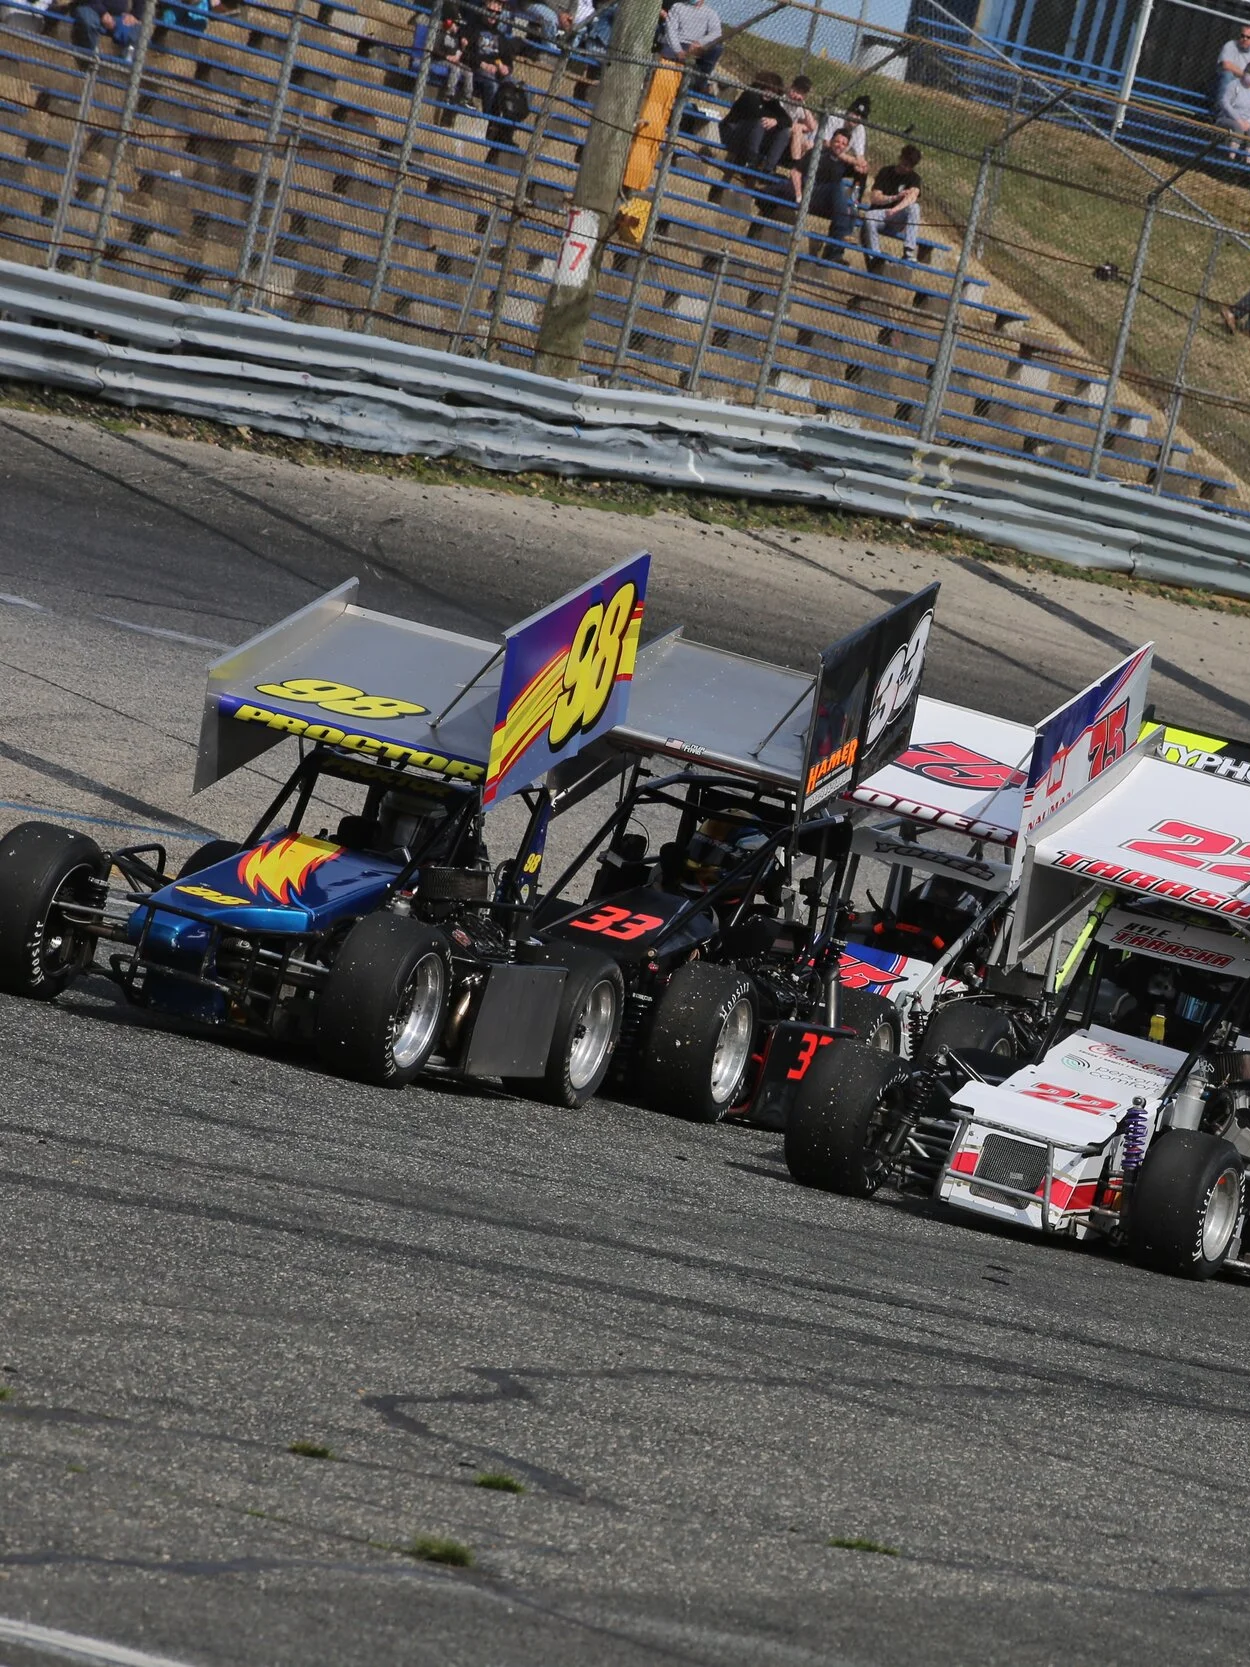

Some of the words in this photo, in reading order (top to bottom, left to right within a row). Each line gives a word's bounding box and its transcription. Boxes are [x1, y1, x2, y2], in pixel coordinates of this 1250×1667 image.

[546, 579, 638, 754] 98
[864, 607, 936, 760] 33
[253, 677, 432, 721] 98
[232, 704, 487, 783] PROCTOR
[805, 736, 859, 796] HAMER
[852, 787, 1014, 844] ODER
[523, 853, 542, 874] 98
[174, 885, 253, 906] 98
[568, 904, 665, 941] 33
[1123, 921, 1172, 941] KYLE
[1109, 930, 1236, 969] TARASHA
[1089, 1071, 1161, 1093] comfort
[1095, 1066, 1168, 1088] persona
[1015, 1081, 1122, 1117] 22
[1191, 1188, 1214, 1262] Hoosier
